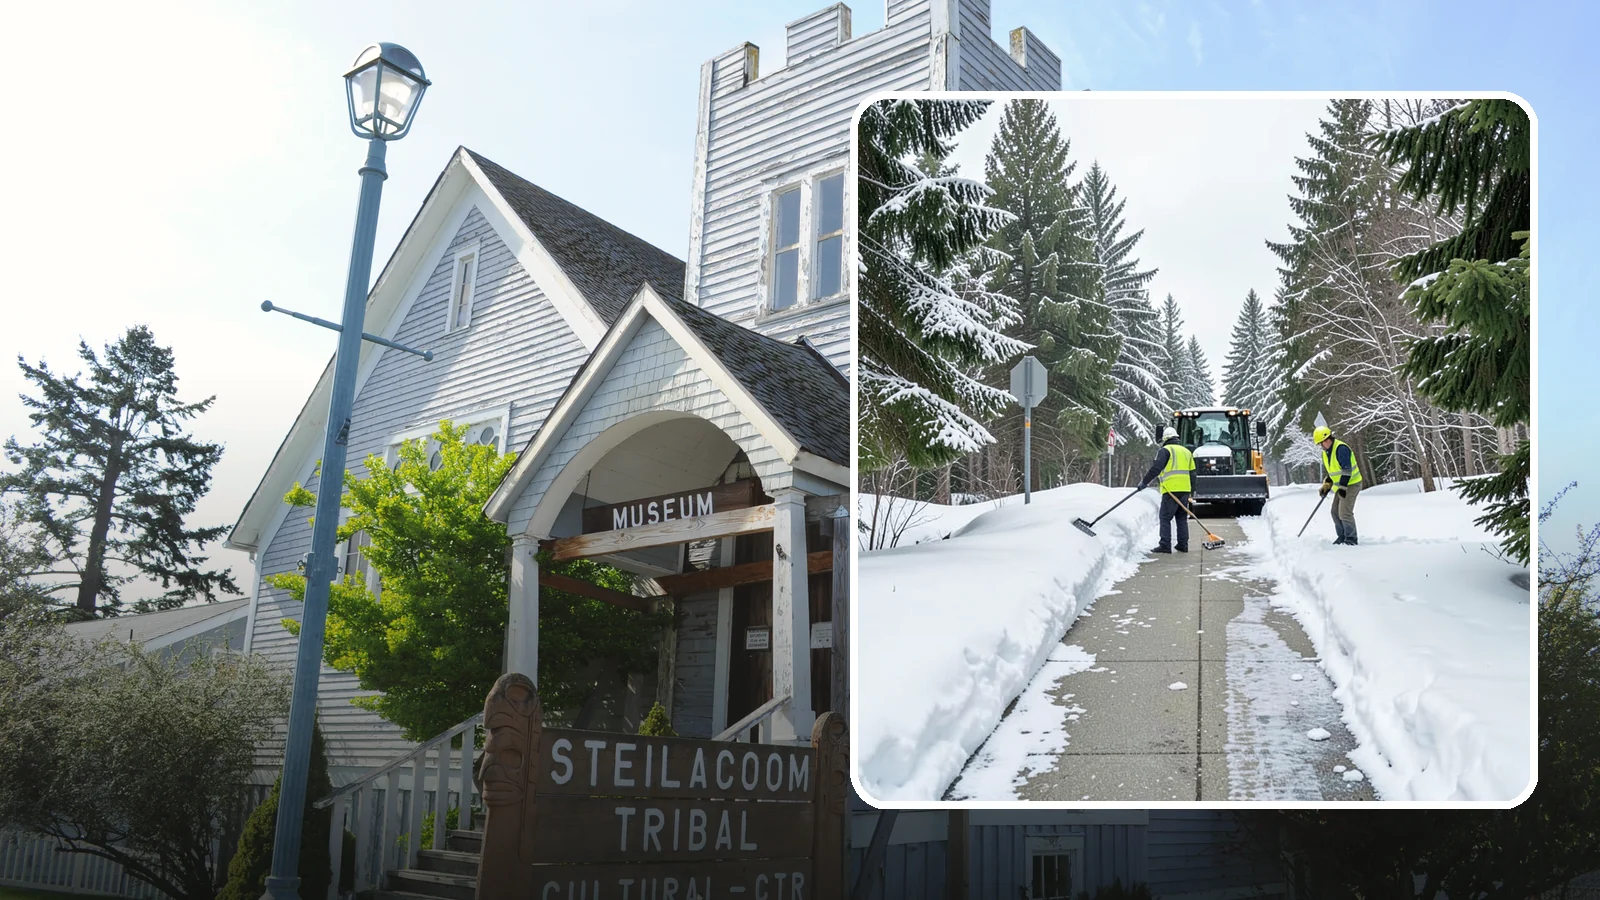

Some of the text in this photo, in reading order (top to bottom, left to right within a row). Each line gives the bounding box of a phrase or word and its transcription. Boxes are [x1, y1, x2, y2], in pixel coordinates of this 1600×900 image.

[612, 491, 713, 530] MUSEUM
[550, 738, 810, 792] STEILACOOM
[615, 806, 757, 852] TRIBAL
